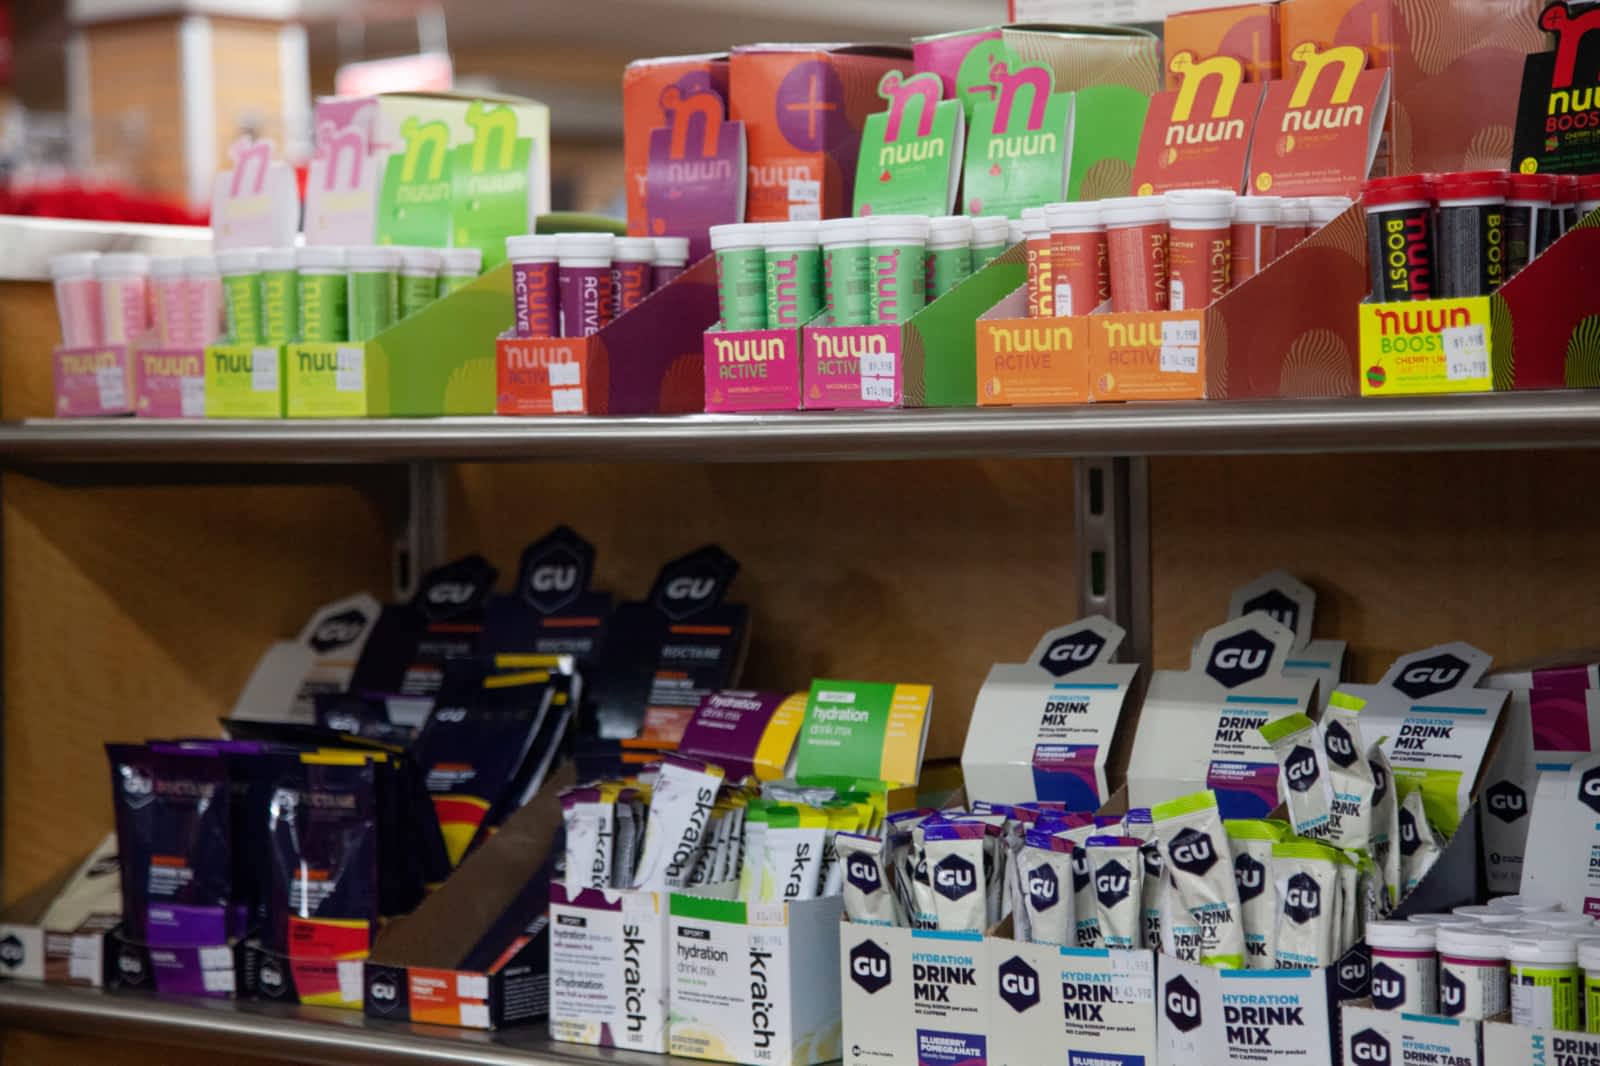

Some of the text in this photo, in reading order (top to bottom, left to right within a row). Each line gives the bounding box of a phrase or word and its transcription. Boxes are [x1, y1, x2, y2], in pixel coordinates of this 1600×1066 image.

[1282, 104, 1363, 132] nuun
[1545, 112, 1598, 132] BOOS
[1166, 119, 1244, 144] nuun
[879, 135, 944, 166] nuun
[987, 131, 1056, 160] nuun
[670, 159, 732, 184] nuun
[1387, 220, 1408, 292] BOOST
[1407, 212, 1430, 300] nuu
[1487, 214, 1501, 287] BOOST
[1098, 243, 1108, 304] ACTIV
[1151, 234, 1165, 304] ACTIVE
[1211, 240, 1224, 301] ACTIV
[776, 254, 798, 324] nuu
[878, 249, 900, 321] nuu
[1028, 250, 1038, 316] ACTIVE
[516, 272, 529, 330] ACTIVE
[529, 266, 548, 337] nuu
[1375, 307, 1471, 336] nuun
[989, 326, 1072, 353] nuun
[1103, 320, 1163, 347] nuu
[714, 336, 785, 362] nuun
[813, 333, 886, 357] nuun
[213, 351, 253, 373] nuu
[297, 350, 338, 372] nuu
[505, 346, 572, 368] nuun
[994, 355, 1051, 369] ACTIVE
[1110, 350, 1156, 365] ACTIV
[720, 363, 767, 379] ACTIVE
[818, 360, 861, 375] ACTIV
[508, 371, 549, 385] ACTIV
[532, 565, 576, 591] GU
[428, 583, 475, 604] GU
[666, 577, 716, 600] GU
[1049, 643, 1098, 662] GU
[1215, 648, 1266, 670] GU
[1404, 667, 1461, 683] GU
[812, 706, 869, 722] hydration
[1045, 702, 1089, 713] DRINK
[1041, 714, 1067, 725] MIX
[1219, 717, 1268, 729] DRINK
[1216, 730, 1244, 742] MIX
[1400, 725, 1455, 738] DRINK
[1328, 736, 1352, 755] GU
[1395, 738, 1426, 749] MIX
[1288, 757, 1314, 780] GU
[1584, 778, 1600, 796] G
[1331, 800, 1361, 817] RINK
[1490, 794, 1523, 810] GU
[1174, 841, 1210, 863] GU
[784, 842, 811, 902] skra
[851, 862, 877, 882] GU
[937, 870, 971, 886] GU
[1030, 879, 1054, 897] GU
[1097, 876, 1126, 892] GU
[1287, 890, 1318, 910] GU
[677, 942, 728, 962] hydration
[912, 953, 973, 965] HYDRATION
[854, 957, 887, 978] GU
[913, 964, 976, 985] DRINK
[1061, 971, 1112, 982] HYDRATI
[1341, 963, 1365, 980] GU
[371, 985, 396, 1000] GU
[914, 983, 949, 1002] MIX
[1002, 973, 1035, 996] GU
[1062, 982, 1113, 1002] DRIN
[1373, 979, 1399, 998] GU
[749, 947, 775, 1048] kratch
[1167, 992, 1198, 1018] GU
[1222, 993, 1299, 1005] HYDRATION
[1064, 1002, 1104, 1022] MIX
[1223, 1006, 1305, 1026] DRINK
[920, 1036, 966, 1046] BLUEBERRY
[1226, 1025, 1272, 1046] MIX
[920, 1044, 981, 1057] POMEGRANATE
[1354, 1042, 1386, 1063] GU
[1402, 1041, 1451, 1053] HYDRATION
[1553, 1038, 1600, 1054] DRIN
[1403, 1049, 1472, 1066] DRINK TABS
